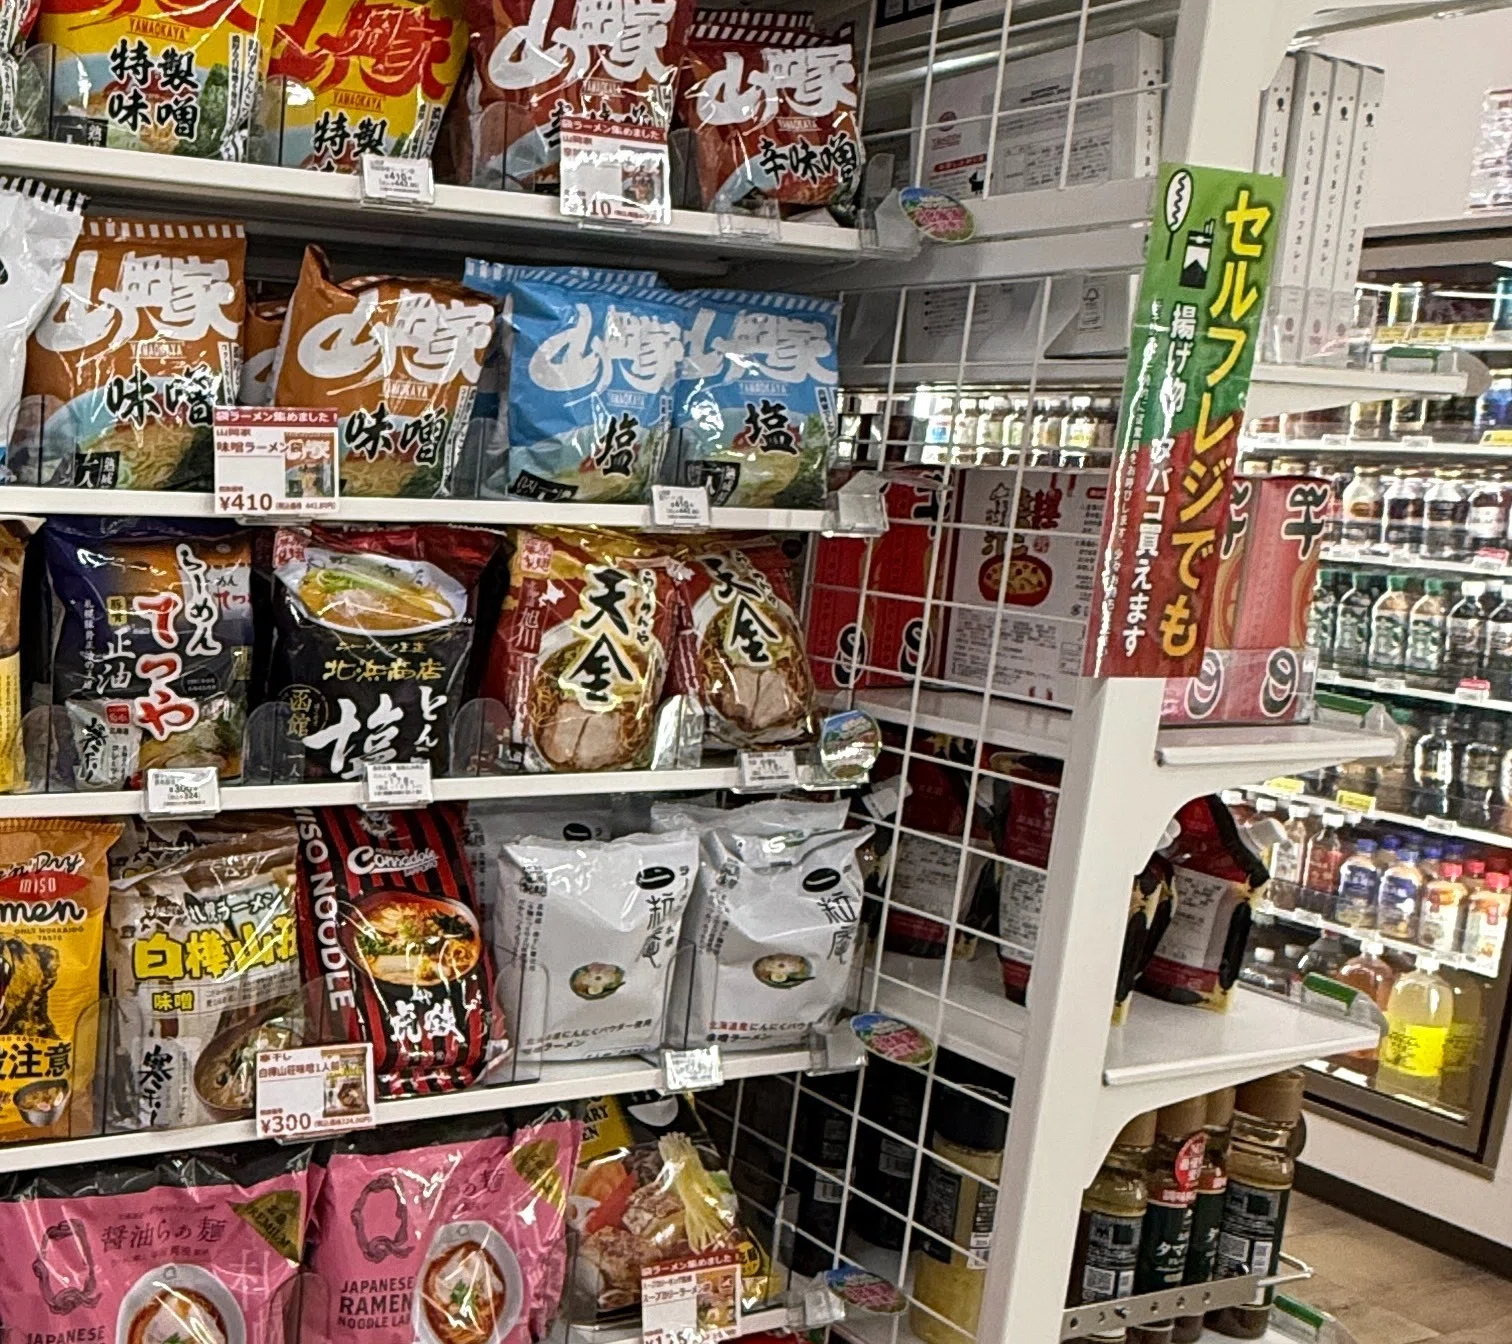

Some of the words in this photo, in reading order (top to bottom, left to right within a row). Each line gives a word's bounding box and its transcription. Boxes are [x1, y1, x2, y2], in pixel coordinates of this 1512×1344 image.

[110, 37, 200, 89] 特製
[108, 90, 200, 142] 味噌
[313, 110, 388, 159] 特製
[757, 134, 861, 189] 辛味噌
[343, 402, 449, 469] 味噌
[597, 412, 640, 480] 塩
[742, 398, 803, 457] 塩
[1157, 189, 1273, 659] セルフレジでも
[219, 492, 274, 513] ¥410
[559, 566, 635, 708] 天金
[18, 876, 57, 895] MISO
[309, 870, 356, 1013] NOODLE
[151, 989, 196, 1012] 味噌
[260, 1112, 313, 1135] ¥300
[100, 1215, 230, 1253] 醤油らぁ麺
[338, 1290, 415, 1316] RAMEN
[339, 1275, 416, 1294] JAPANESE
